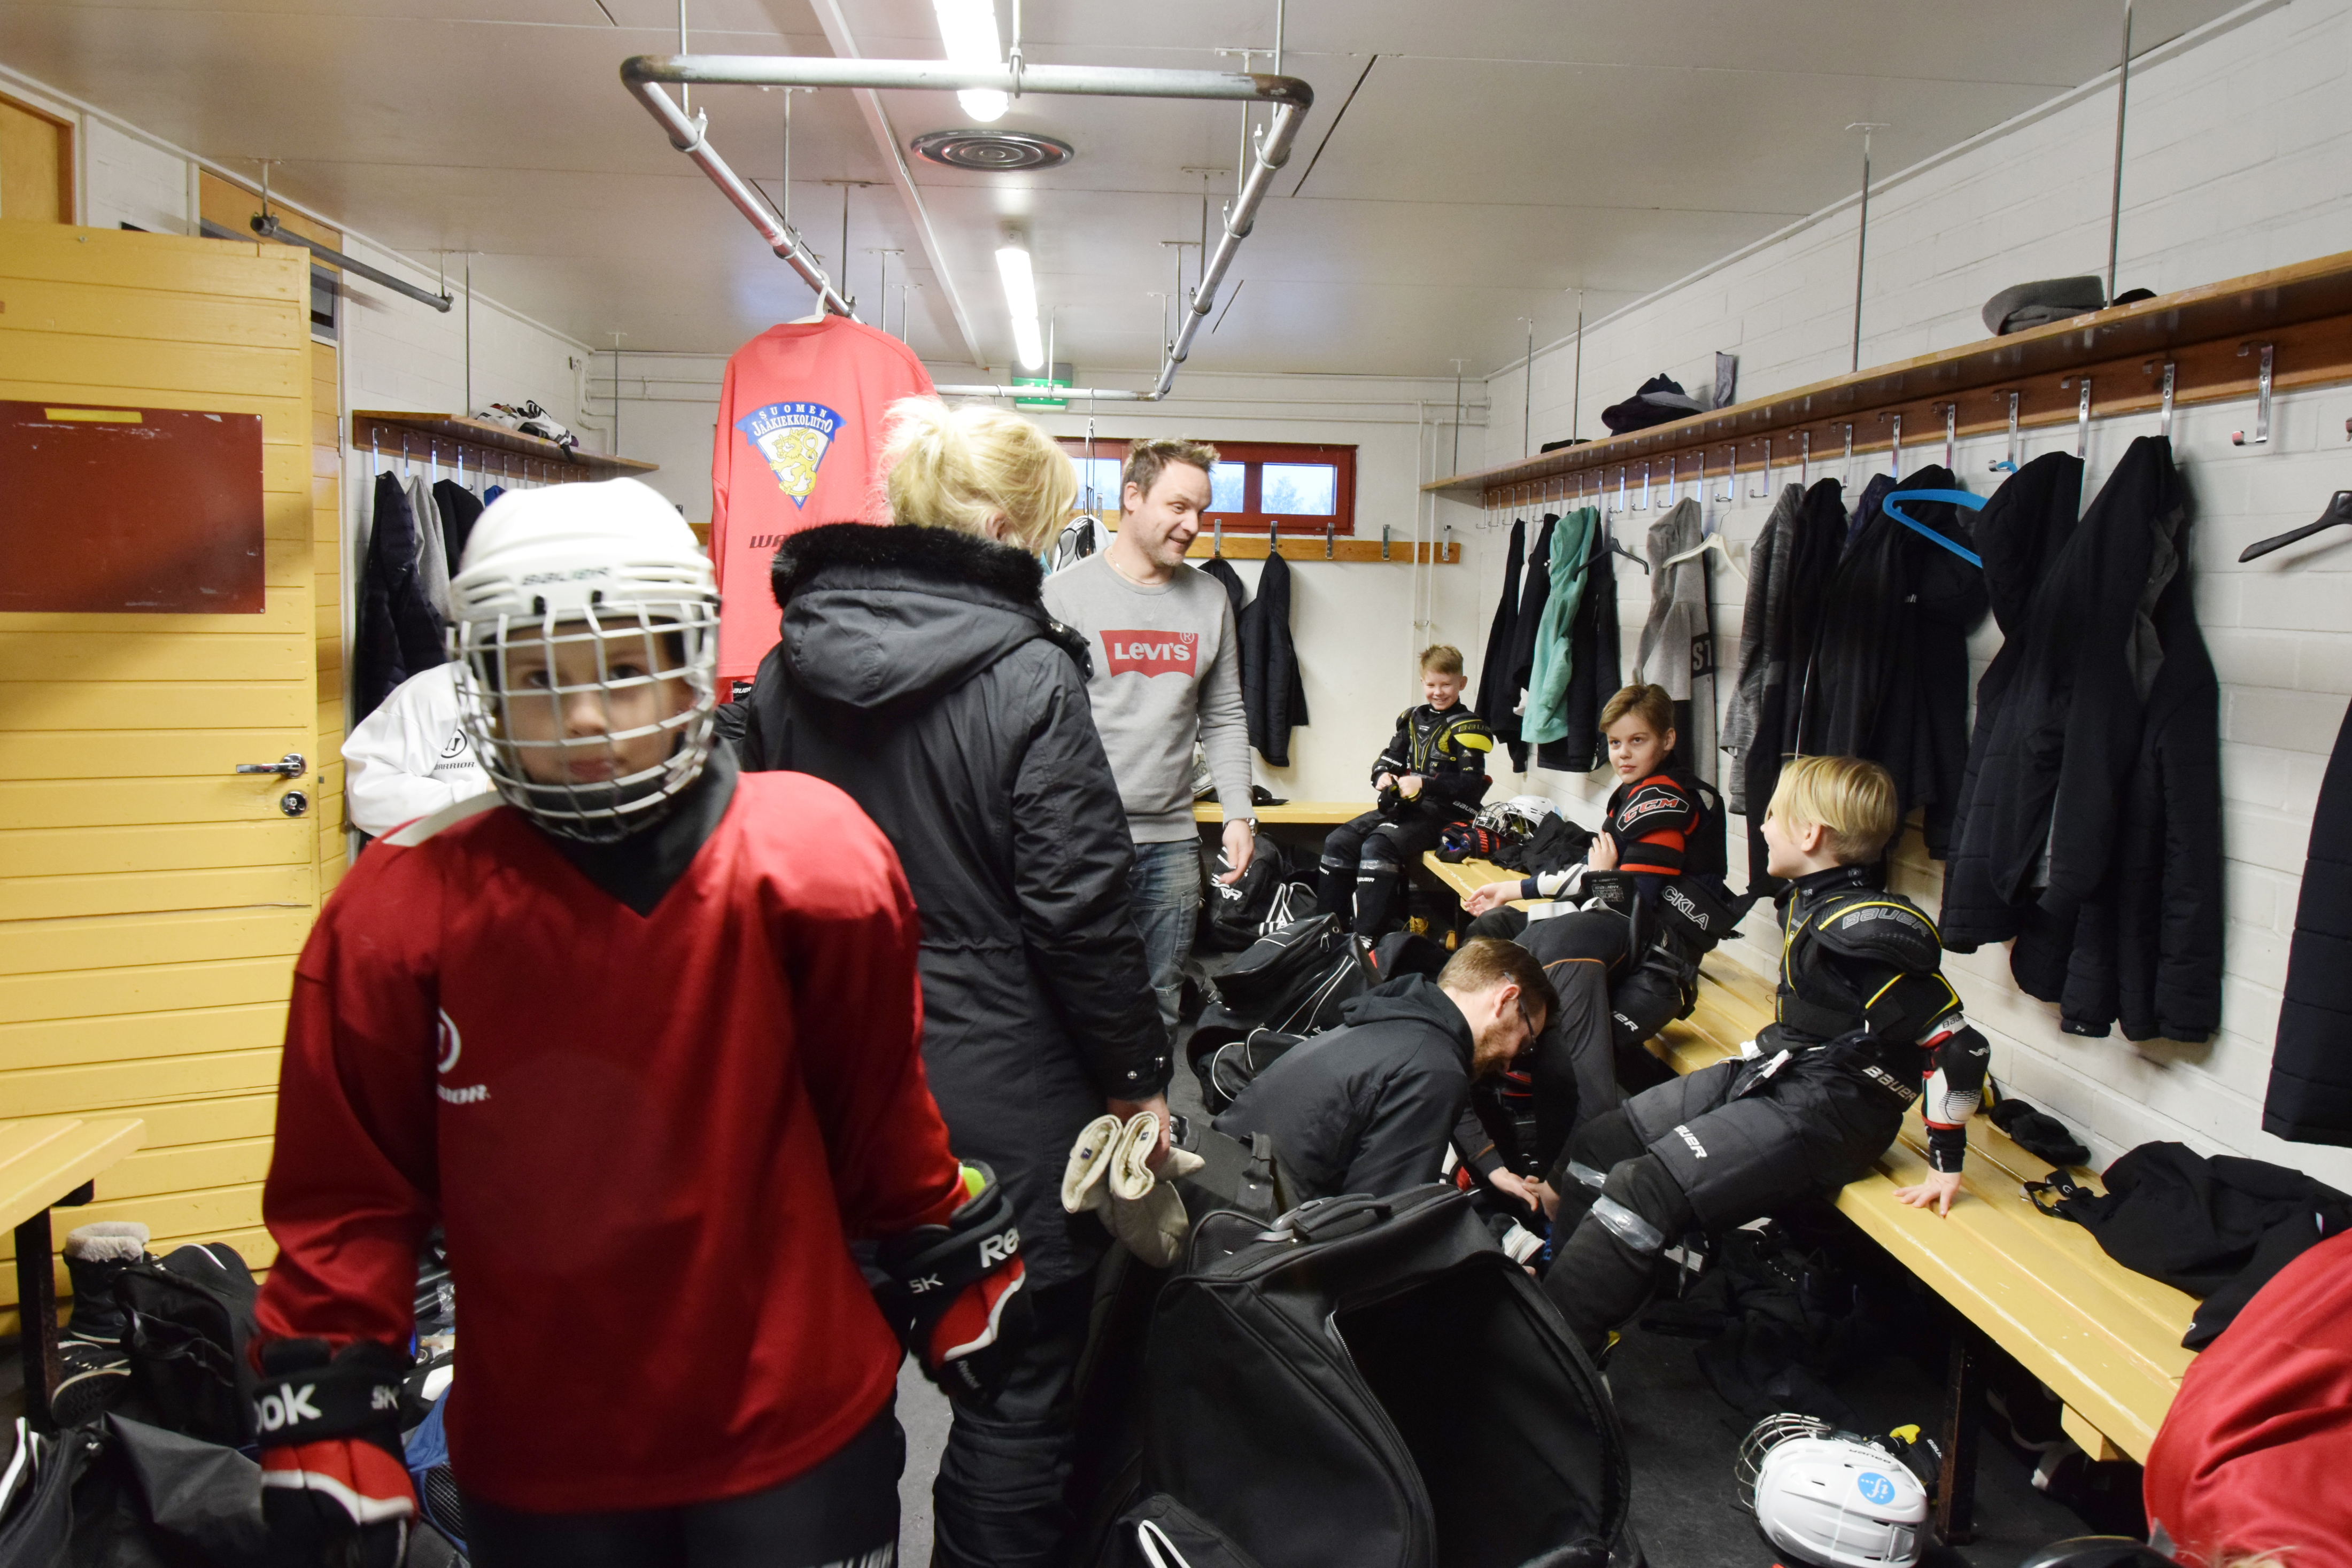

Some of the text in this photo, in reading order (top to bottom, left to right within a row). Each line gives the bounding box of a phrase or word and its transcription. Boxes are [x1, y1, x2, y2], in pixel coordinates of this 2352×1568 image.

[759, 404, 827, 419] SUOMEN
[752, 414, 833, 436] JÄÄKIEKKOLIITTO
[1623, 798, 1680, 823] CCM
